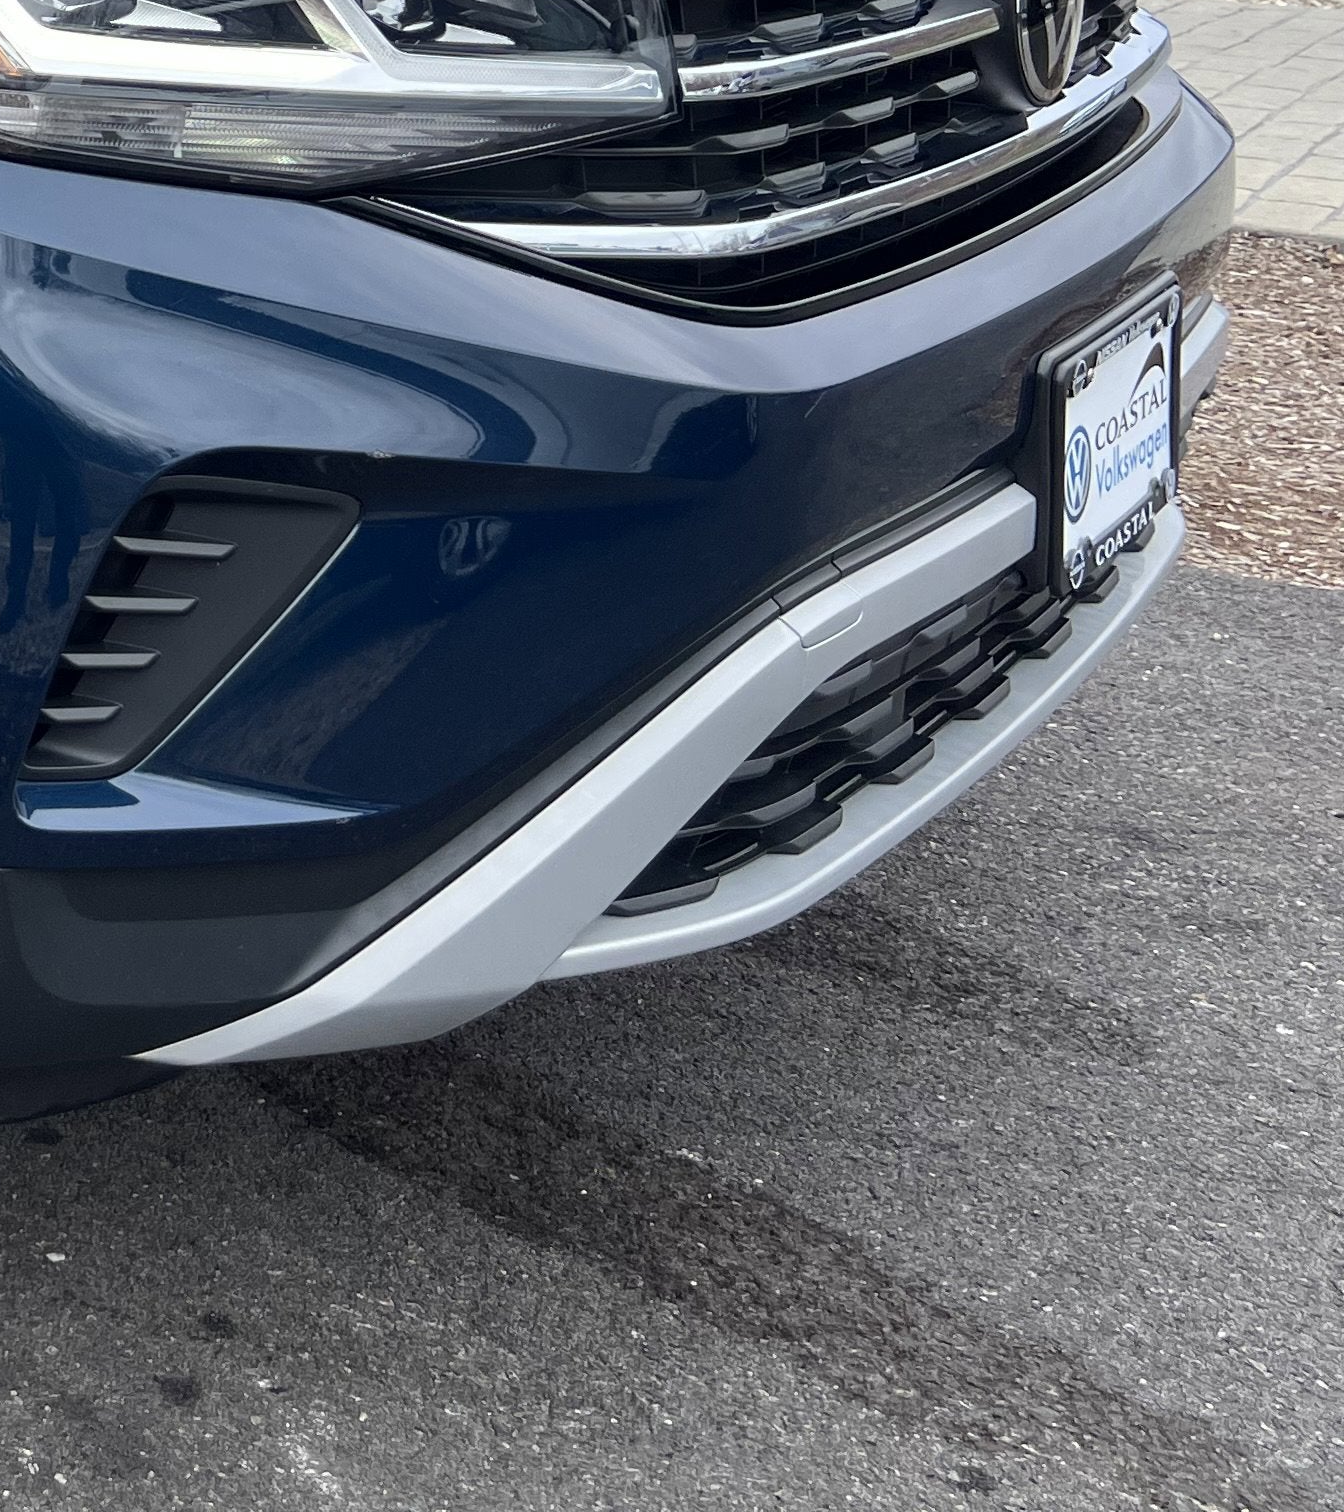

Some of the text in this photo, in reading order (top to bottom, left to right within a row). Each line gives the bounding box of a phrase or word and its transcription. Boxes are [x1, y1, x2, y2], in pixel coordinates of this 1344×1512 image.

[1094, 378, 1168, 451] COASTAL
[1094, 421, 1168, 499] Volkswagen
[1094, 500, 1154, 567] COASTAL
